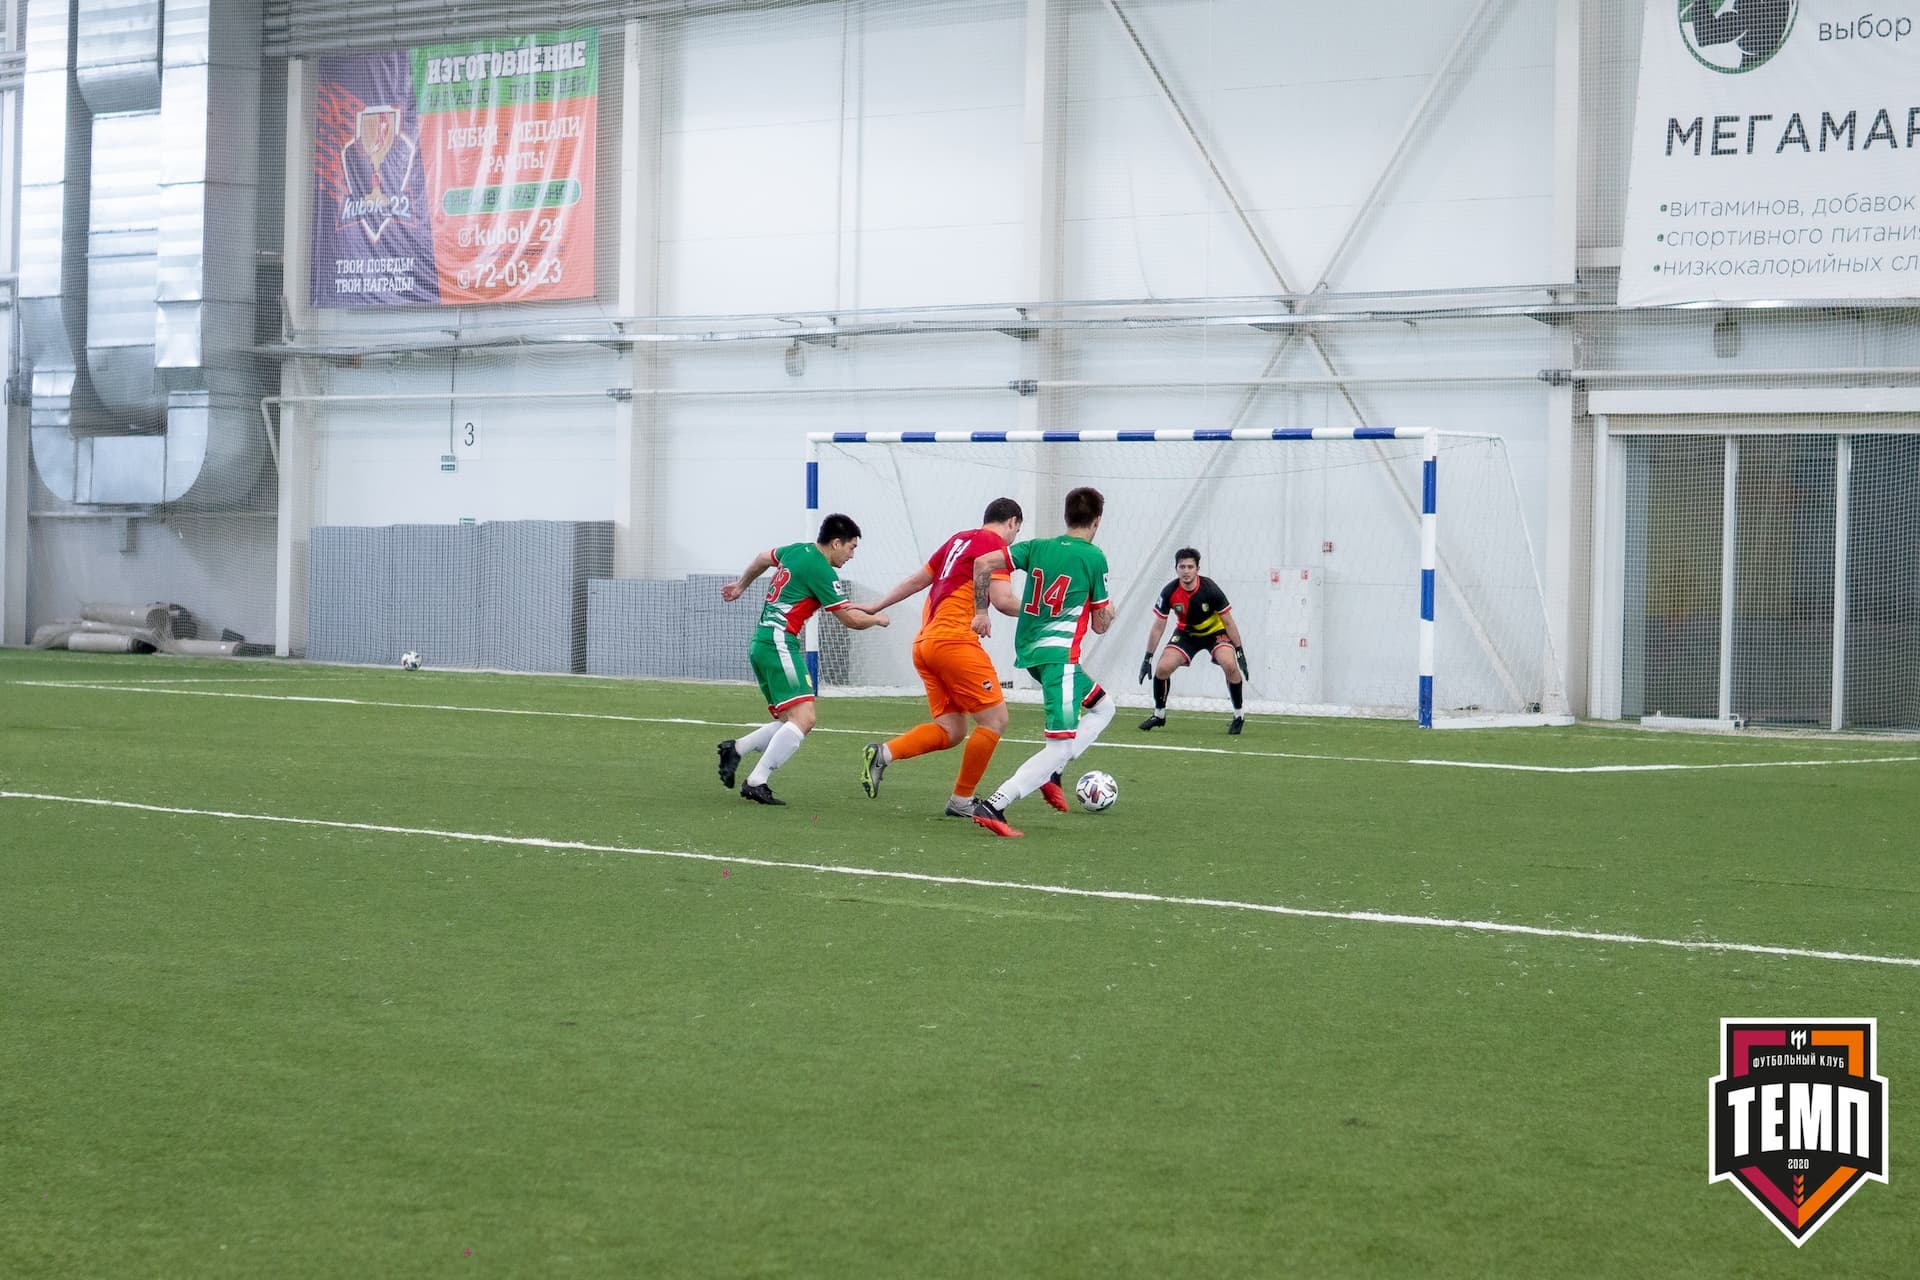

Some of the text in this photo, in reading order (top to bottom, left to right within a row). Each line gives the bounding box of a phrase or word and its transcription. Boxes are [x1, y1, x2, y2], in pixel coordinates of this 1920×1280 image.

[1818, 14, 1912, 41] выбор
[427, 41, 587, 85] ИЗГОТОВЛЕНИЕ
[447, 124, 498, 149] КУБКИ
[1670, 193, 1915, 217] витаминов, добавок
[1667, 222, 1920, 252] спортивного питани
[336, 258, 414, 273] ТВОИ ПОБЕДЫ!
[475, 258, 562, 288] 72-03-23
[1663, 254, 1918, 278] низкокалорийных сл
[335, 277, 414, 293] ТВОИ НАГРАДЫ!
[464, 422, 475, 446] 3
[1024, 567, 1072, 617] 14
